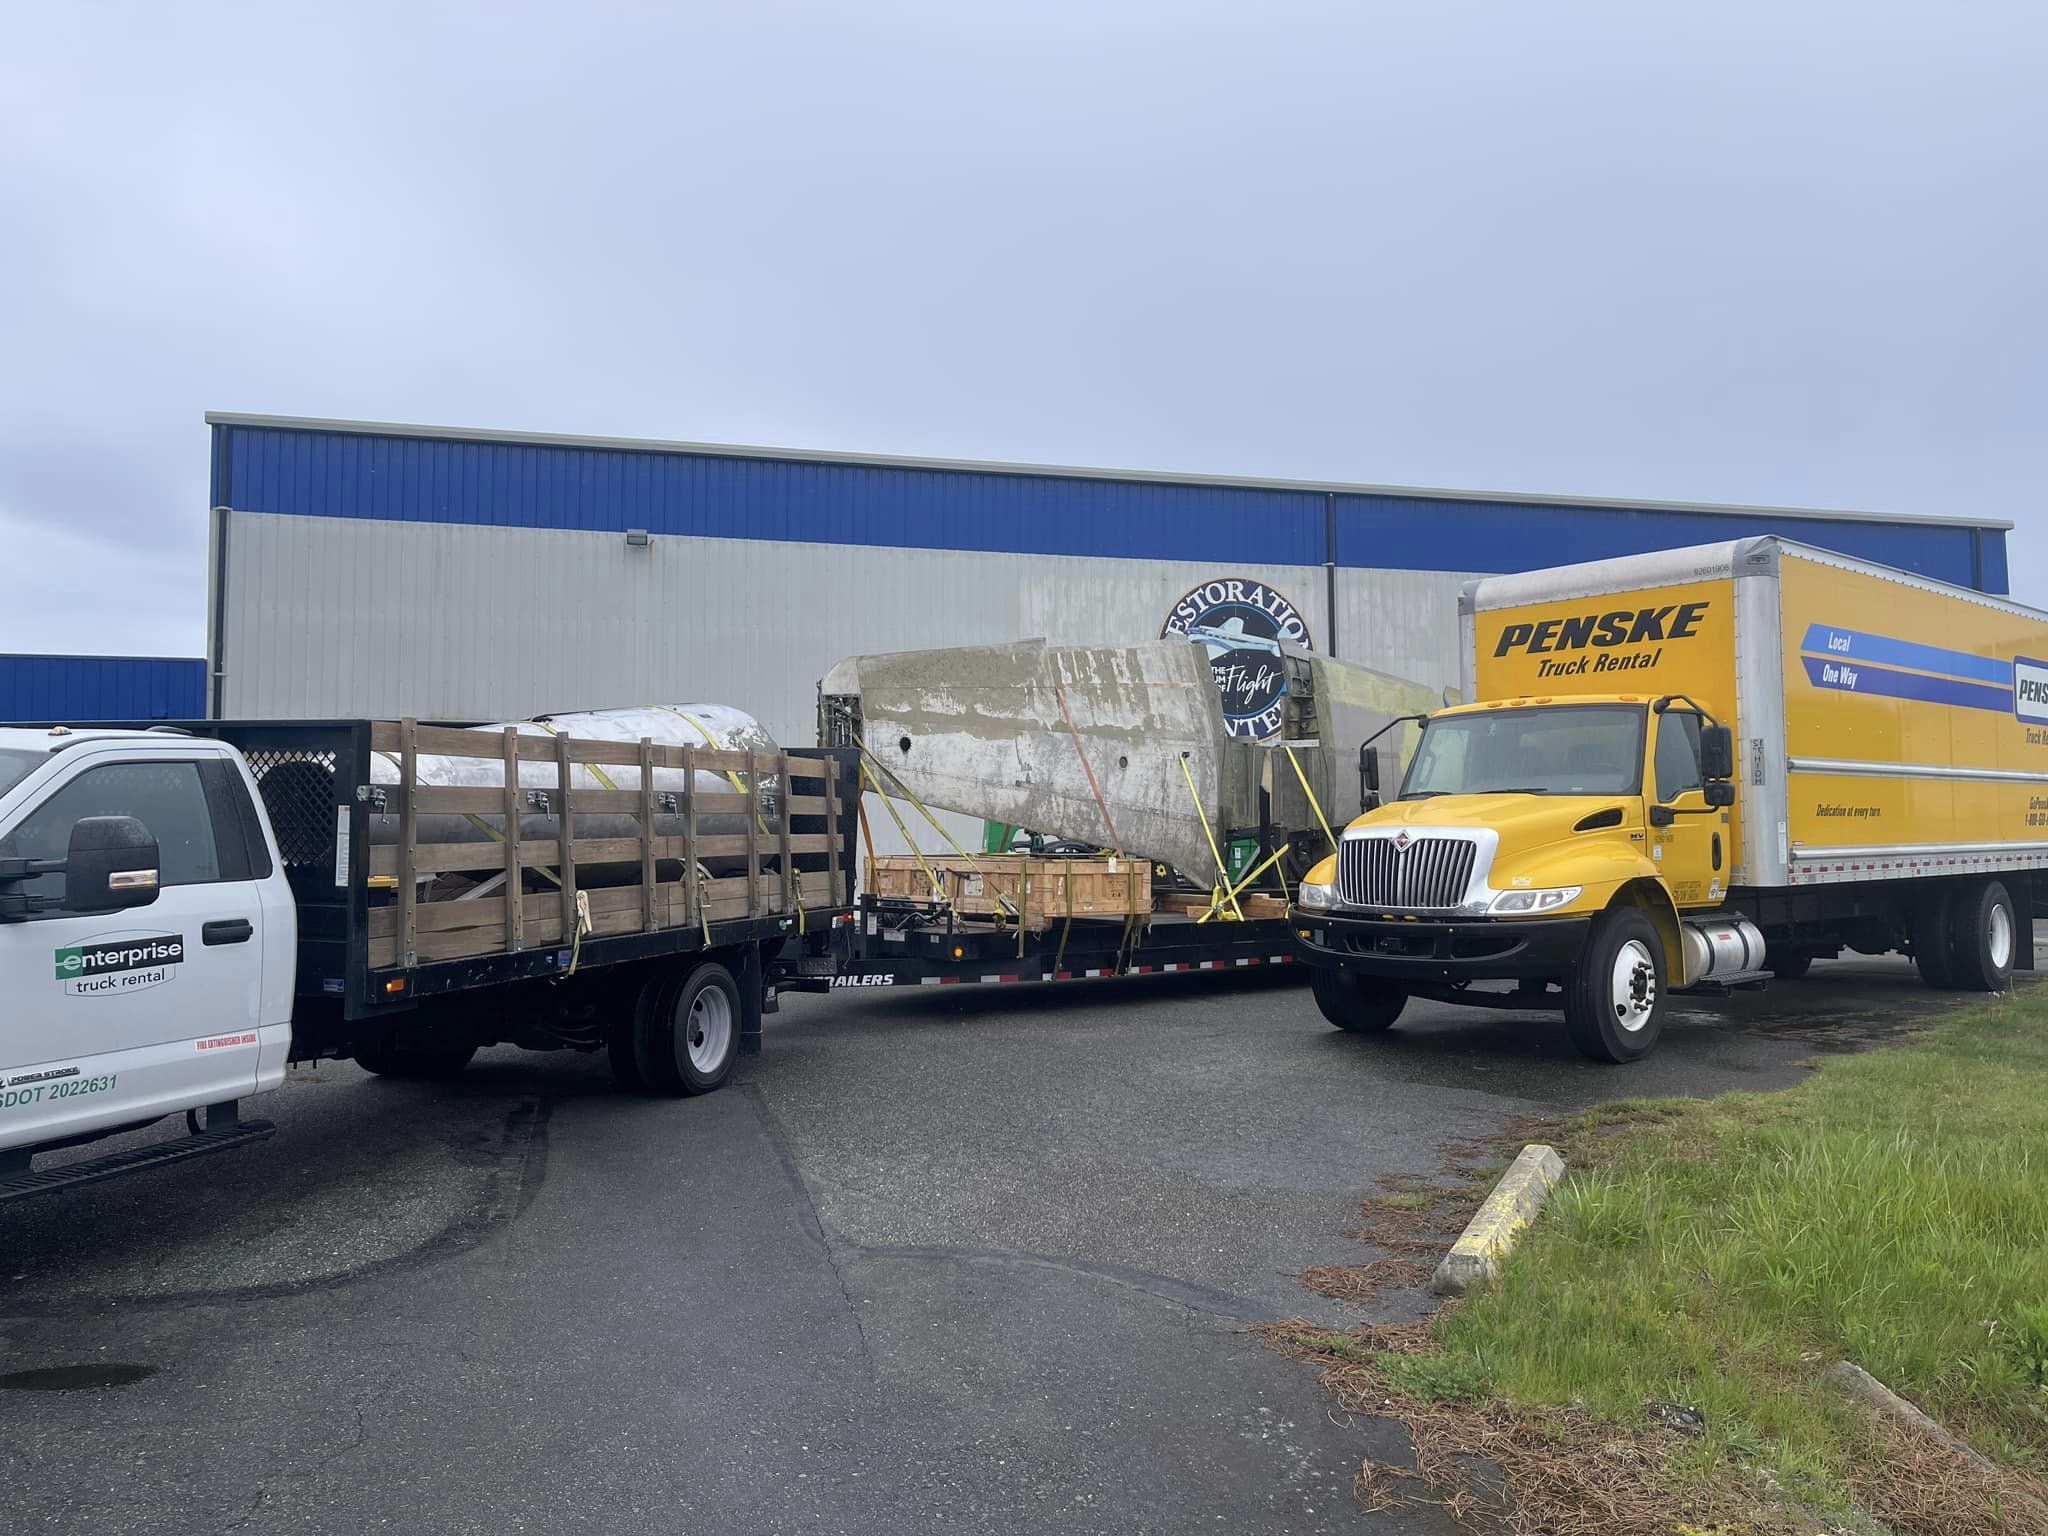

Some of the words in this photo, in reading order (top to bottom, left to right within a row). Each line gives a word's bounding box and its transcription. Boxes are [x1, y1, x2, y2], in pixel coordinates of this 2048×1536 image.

[1165, 580, 1311, 649] ESTORATIO
[1493, 601, 1710, 657] PENSKE
[1828, 631, 1851, 652] Local
[1537, 655, 1589, 678] Truck
[1593, 648, 1662, 673] Rental
[1823, 663, 1839, 683] One
[1840, 666, 1858, 689] Way
[1225, 664, 1282, 705] Flight
[1224, 700, 1281, 737] NTE
[2026, 728, 2041, 744] Truck
[1816, 803, 1846, 816] Dedication
[1847, 806, 1854, 816] at
[1854, 807, 1869, 820] every
[63, 942, 182, 971] enterprise
[76, 975, 116, 993] truck
[122, 967, 165, 986] rental
[813, 974, 895, 987] RAILERS
[197, 1040, 207, 1050] FIRE
[241, 1033, 257, 1044] INSIDE
[11, 1072, 42, 1083] POWER
[44, 1066, 79, 1078] STROKE
[48, 1074, 117, 1100] 2022631
